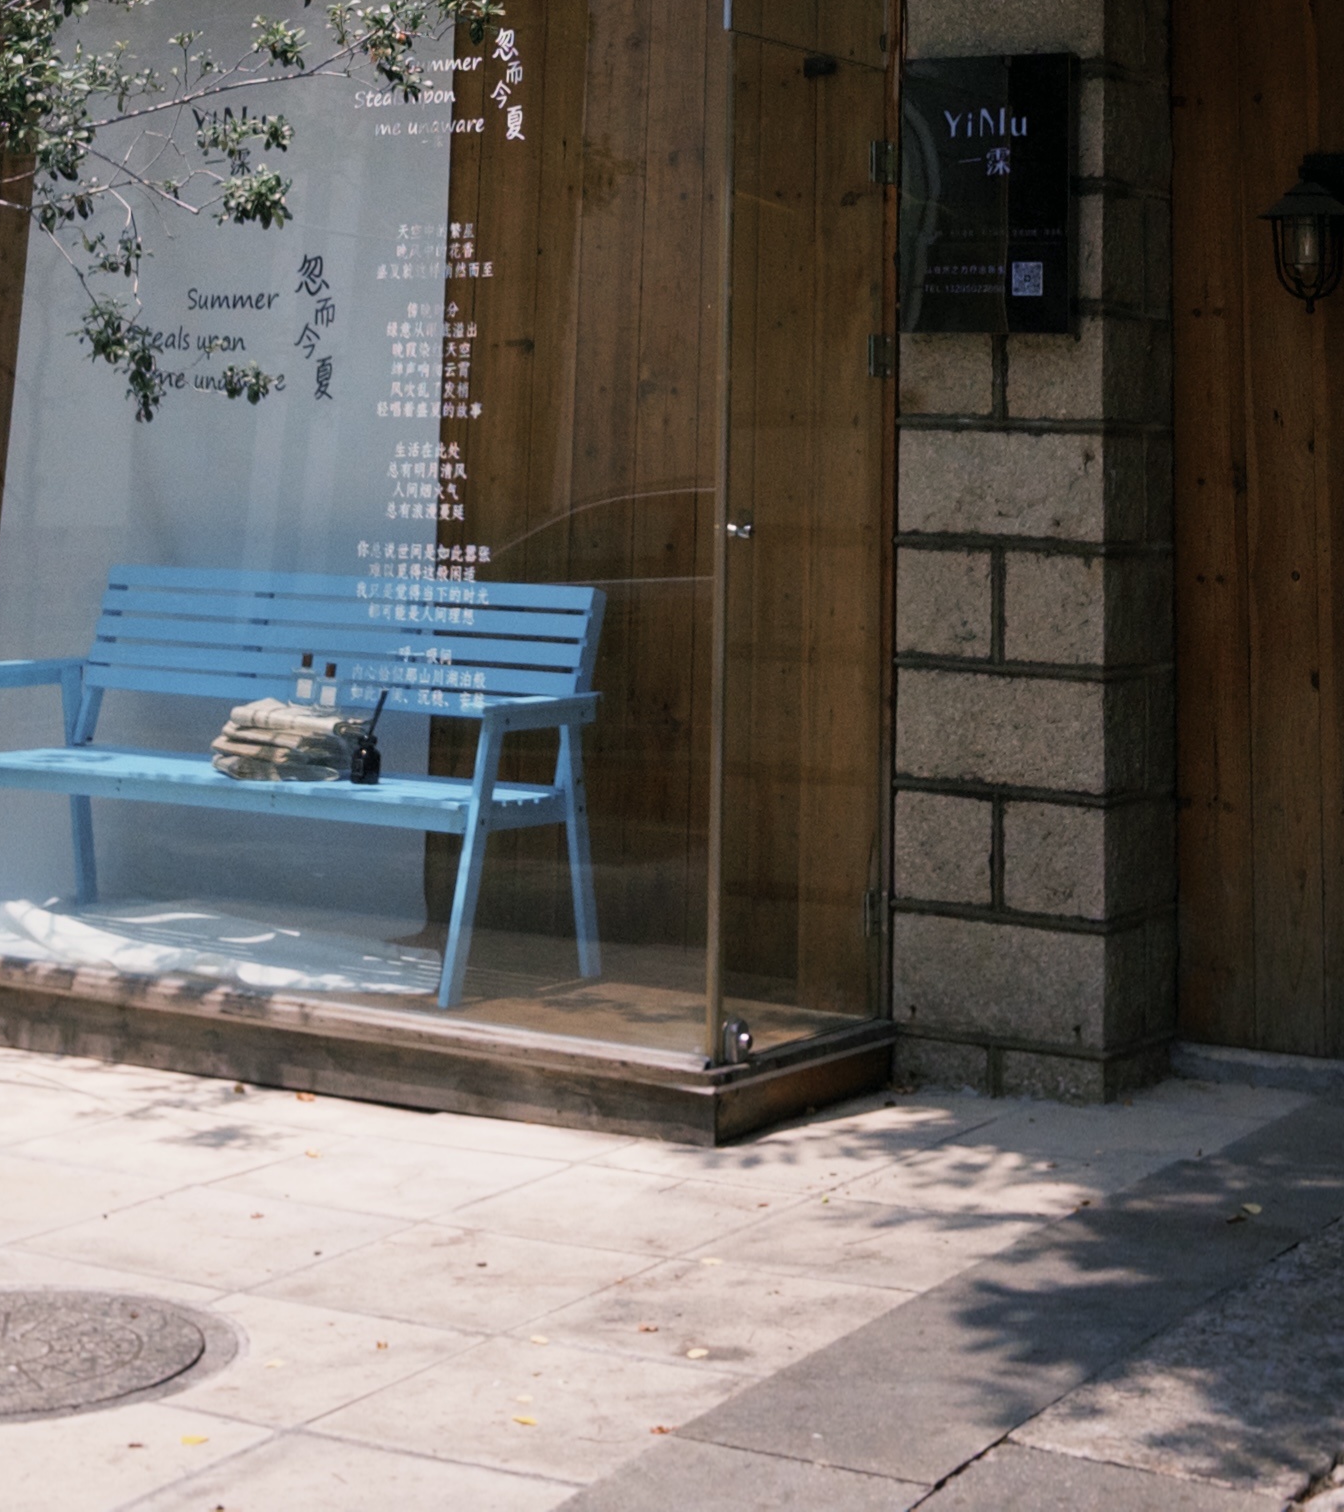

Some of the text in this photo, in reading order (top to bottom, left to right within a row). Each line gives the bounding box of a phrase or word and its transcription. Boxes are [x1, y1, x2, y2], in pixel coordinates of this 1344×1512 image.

[490, 28, 526, 141] 忽而今夏
[374, 117, 486, 136] me unaware
[187, 287, 280, 310] Summer
[294, 254, 336, 401] 忽而今夏
[386, 461, 468, 480] 总有明月清风
[392, 481, 460, 501] 人间烟火气
